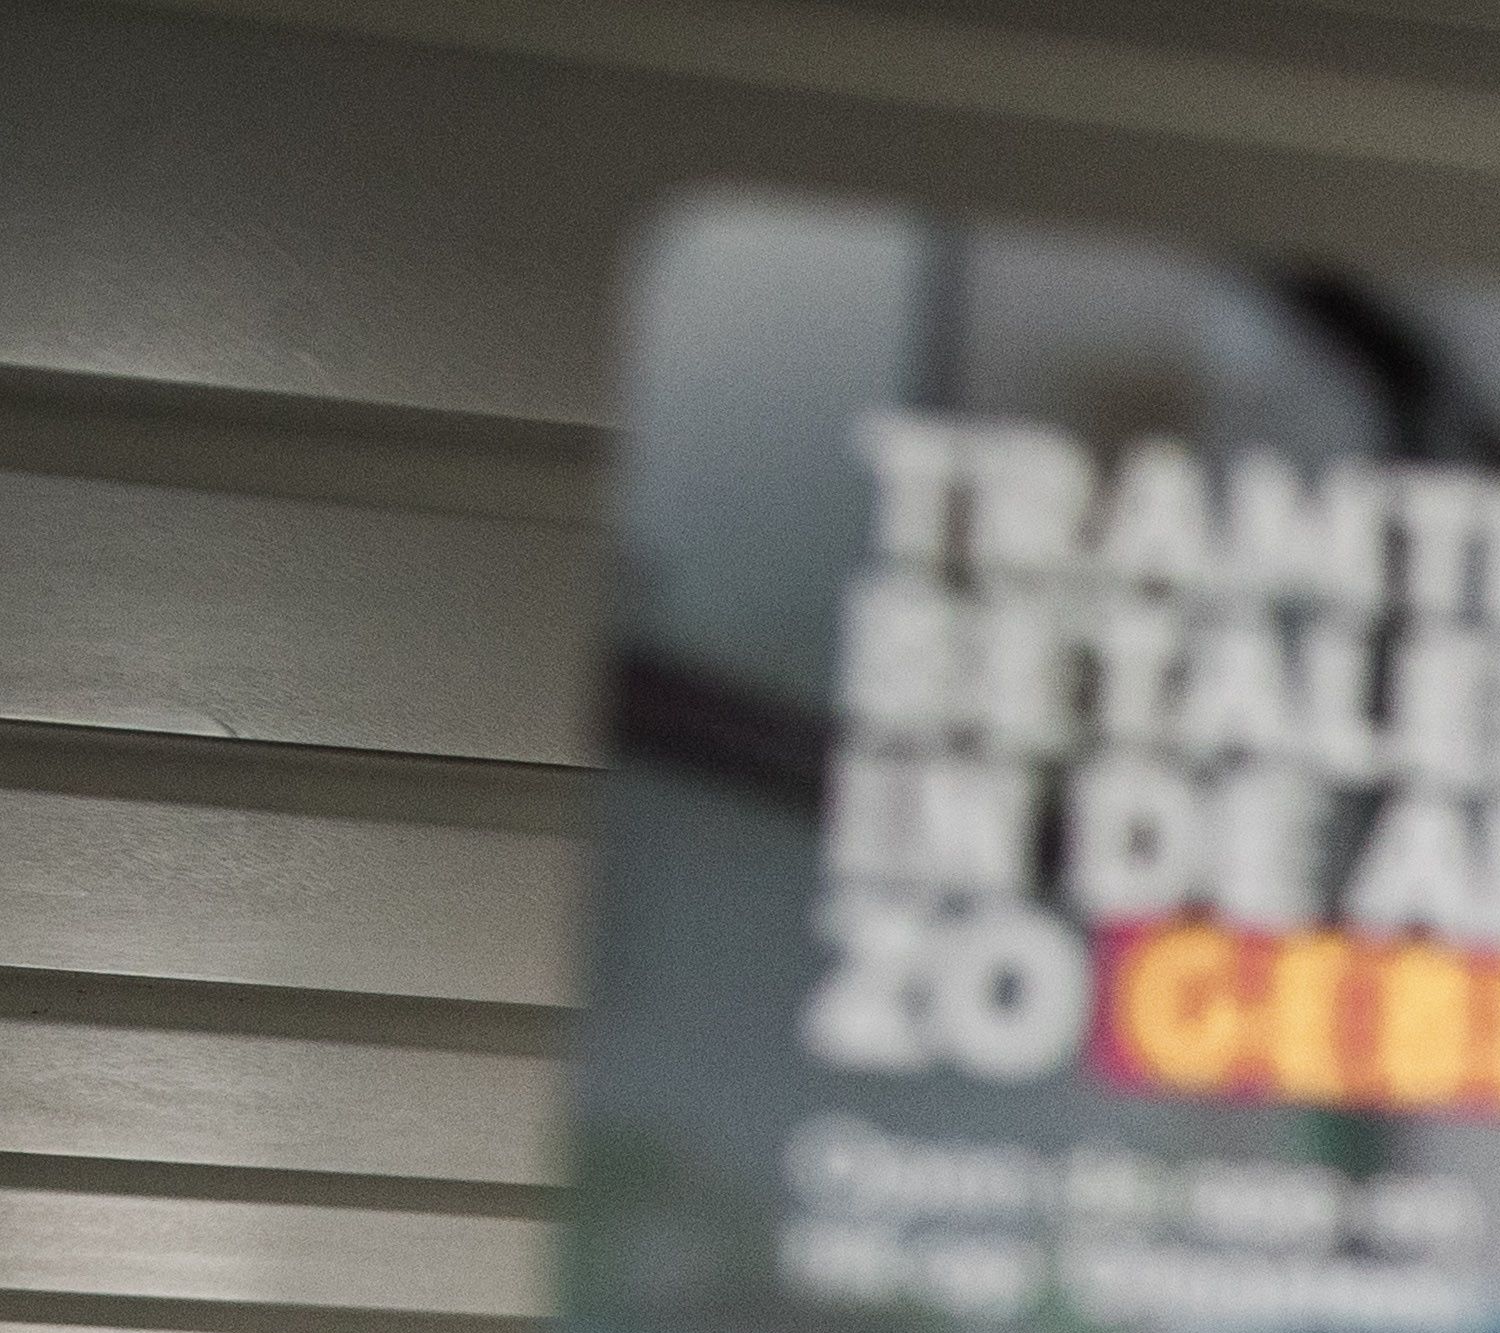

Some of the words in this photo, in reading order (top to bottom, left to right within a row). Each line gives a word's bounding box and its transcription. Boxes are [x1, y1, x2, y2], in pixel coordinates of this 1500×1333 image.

[824, 752, 1032, 888] IN
[1068, 762, 1320, 928] DE
[806, 895, 1092, 1080] ZO
